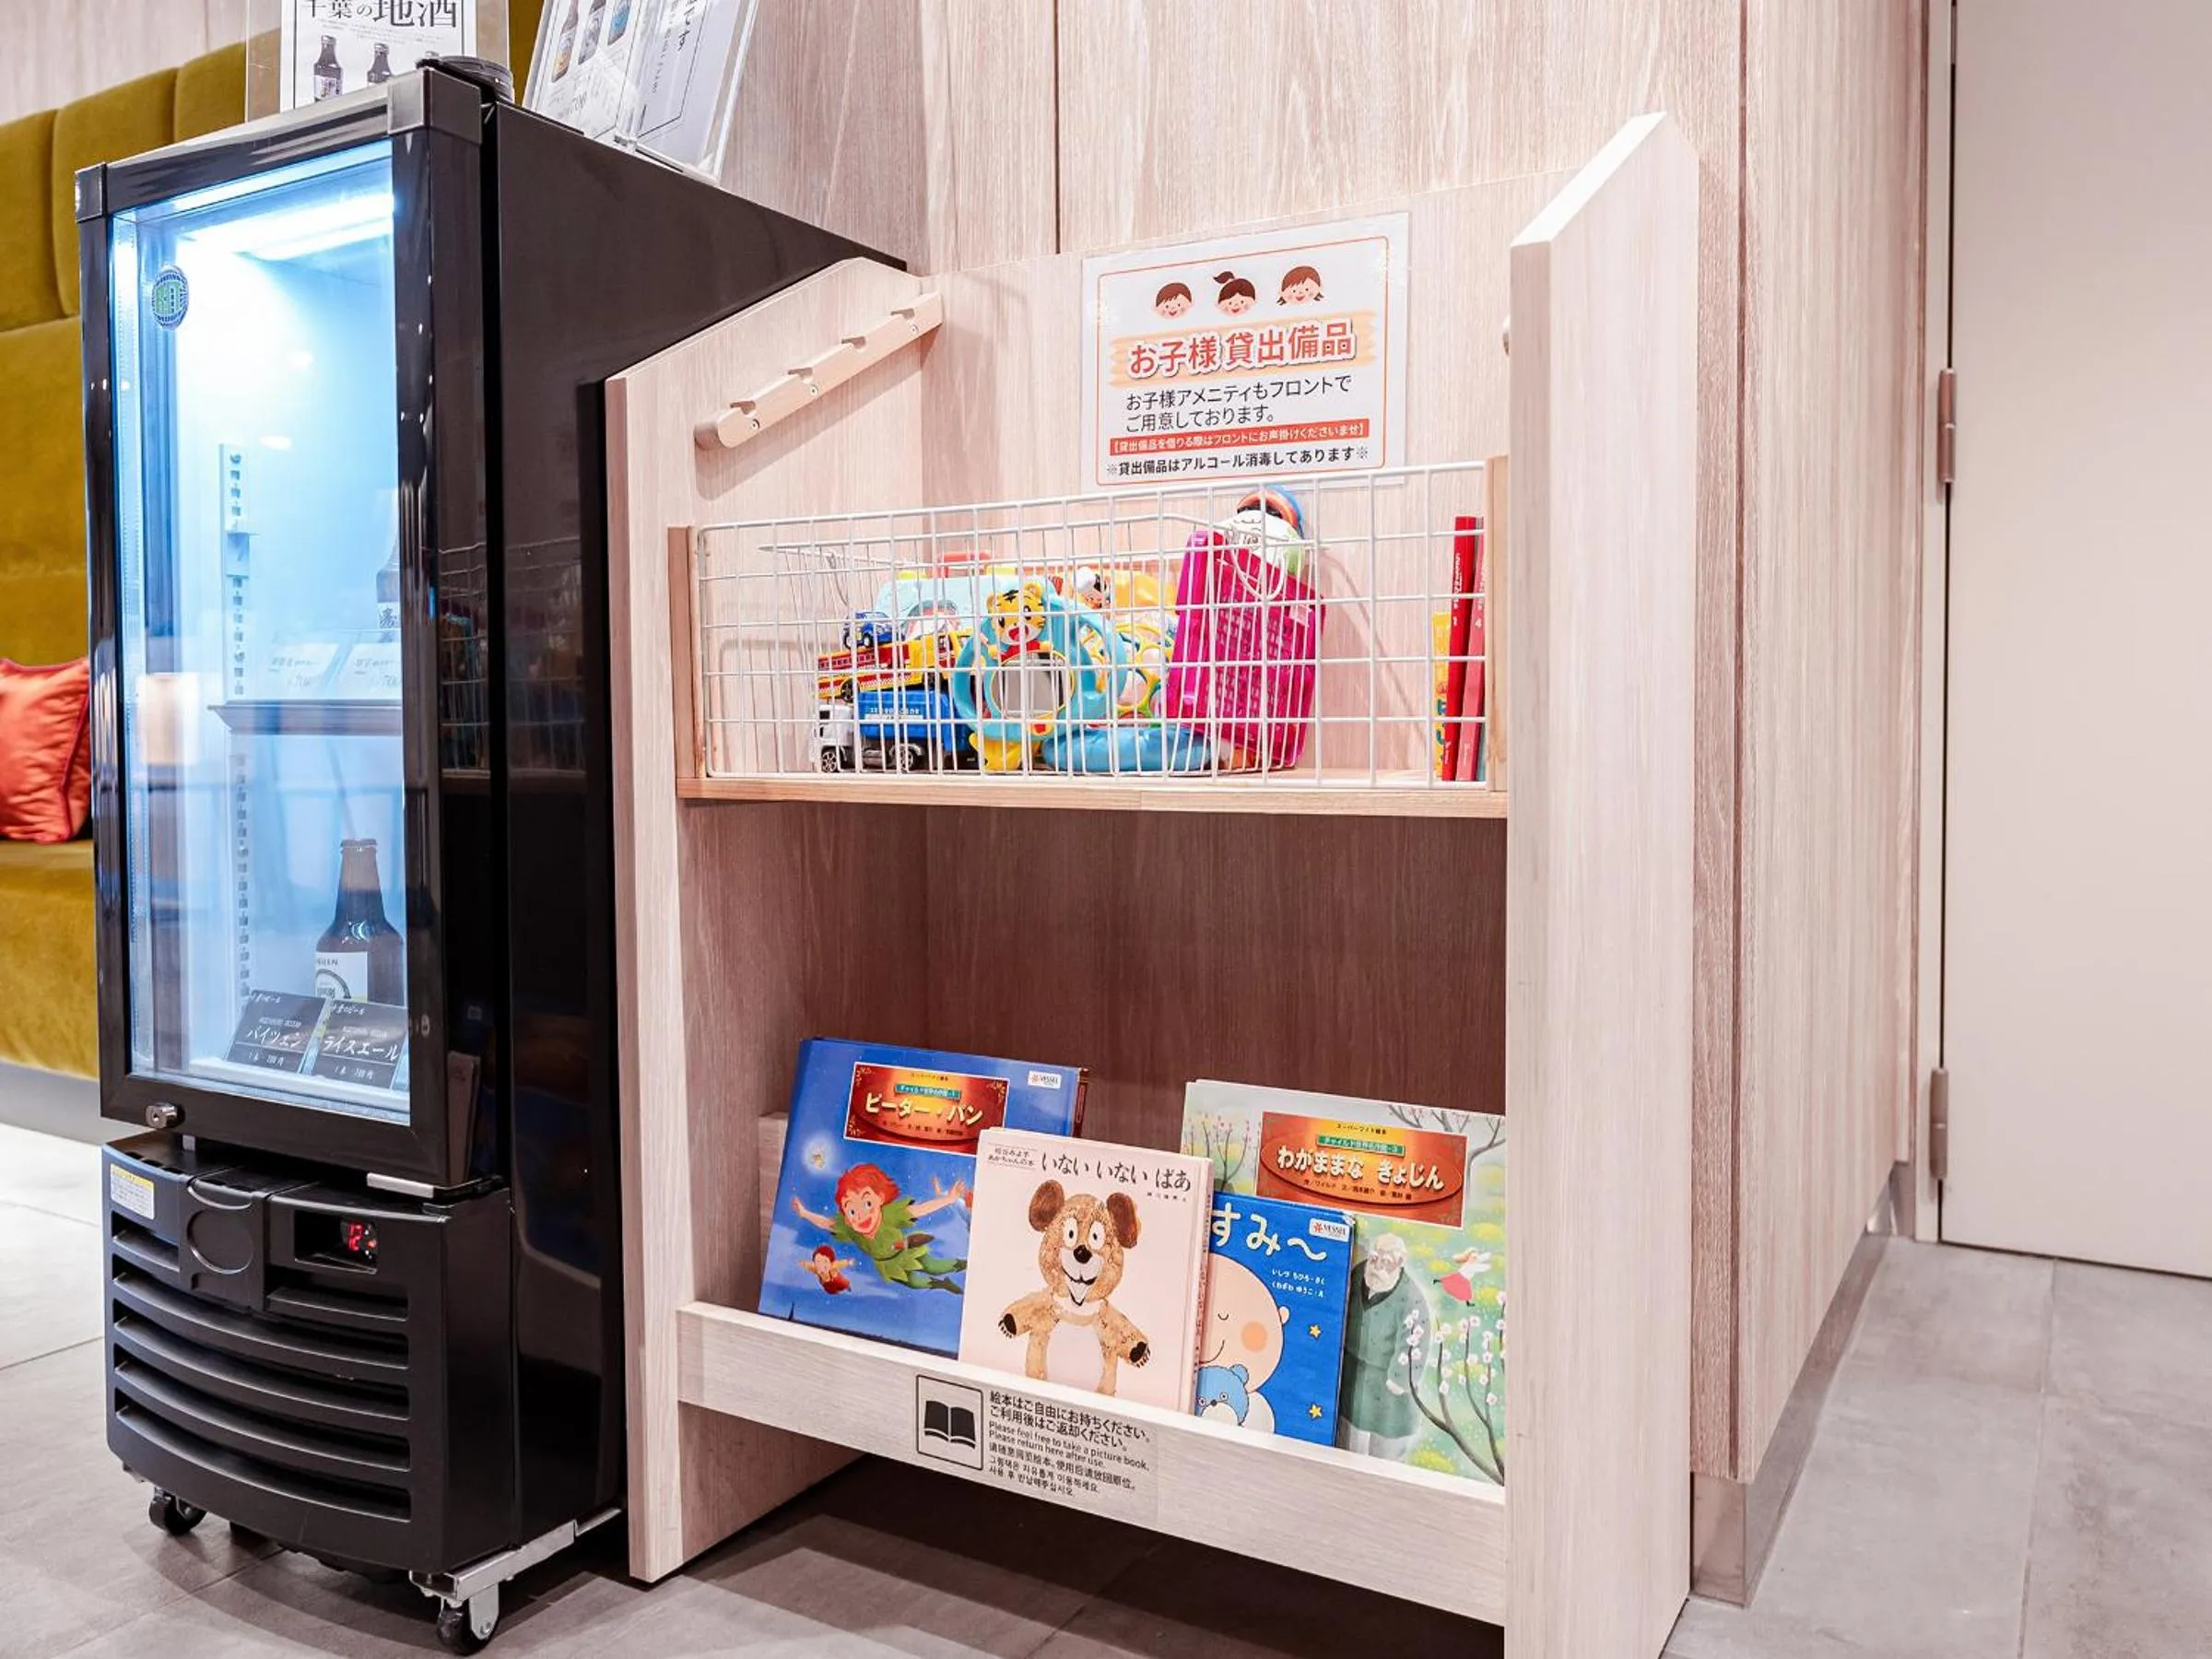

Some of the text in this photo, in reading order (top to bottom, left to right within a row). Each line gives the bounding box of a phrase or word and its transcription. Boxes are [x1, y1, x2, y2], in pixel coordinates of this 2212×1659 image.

[1129, 321, 1353, 375] お子様貸出備品
[1126, 375, 1352, 411] お子様アメニティもフロントで
[1126, 405, 1274, 433] ご用意しております。
[1277, 1145, 1445, 1190] わがままな きょじん
[989, 1390, 1150, 1443] 絵本はご自由にお持ちください。
[990, 1405, 1127, 1453] ご利用後はご返却ください。
[989, 1420, 1016, 1435] Please
[1034, 1431, 1051, 1444] free
[1090, 1448, 1122, 1464] picture
[989, 1430, 1016, 1444] Please
[1017, 1439, 1043, 1452] return
[1044, 1444, 1063, 1456] here
